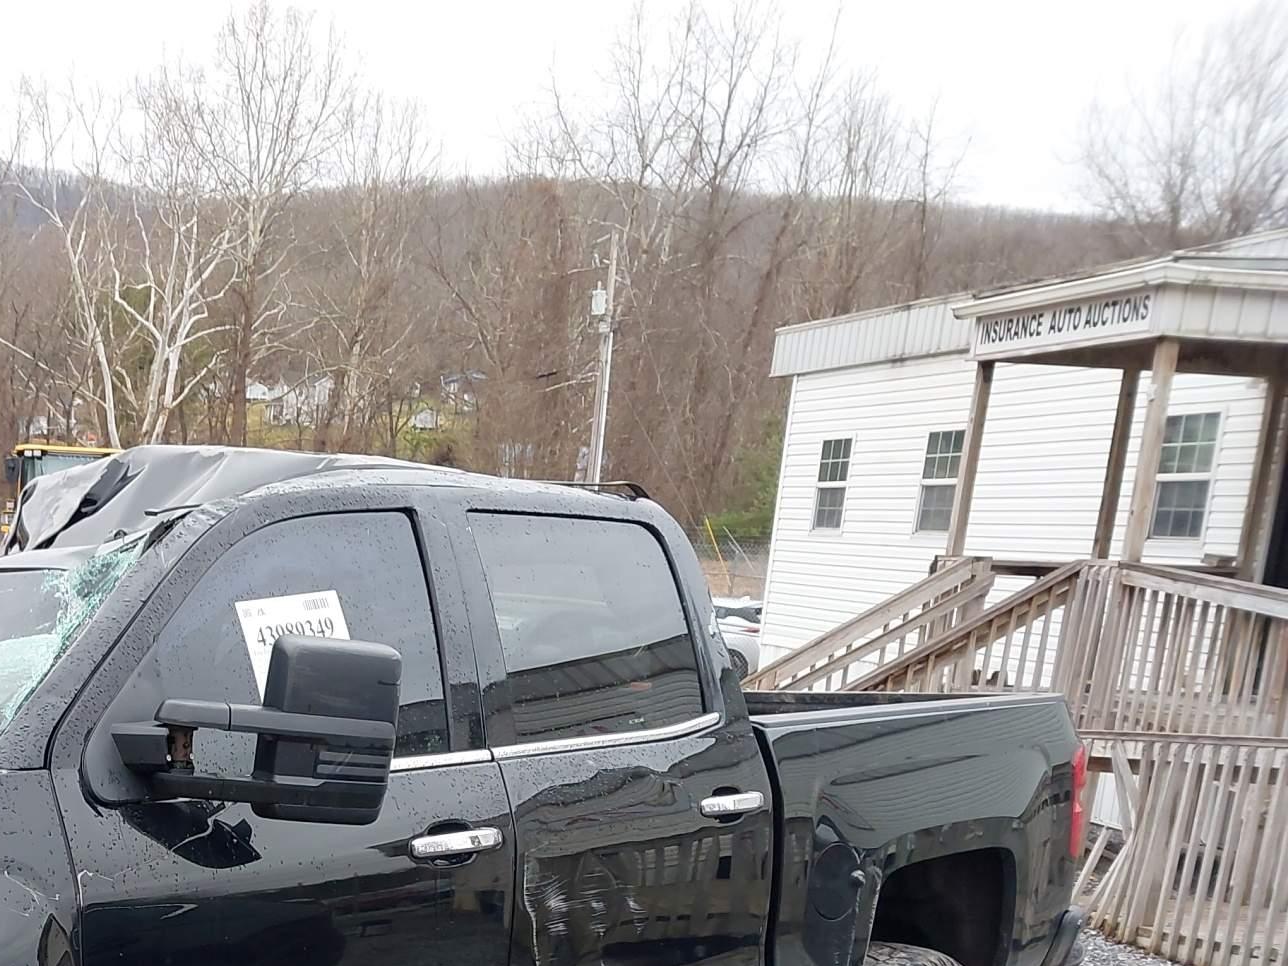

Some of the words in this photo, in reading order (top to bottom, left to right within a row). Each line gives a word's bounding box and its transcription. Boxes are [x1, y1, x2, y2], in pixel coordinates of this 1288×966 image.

[981, 313, 1043, 345] INSURANCE
[1048, 306, 1081, 334] AUTO
[1083, 295, 1150, 329] AUCTIONS
